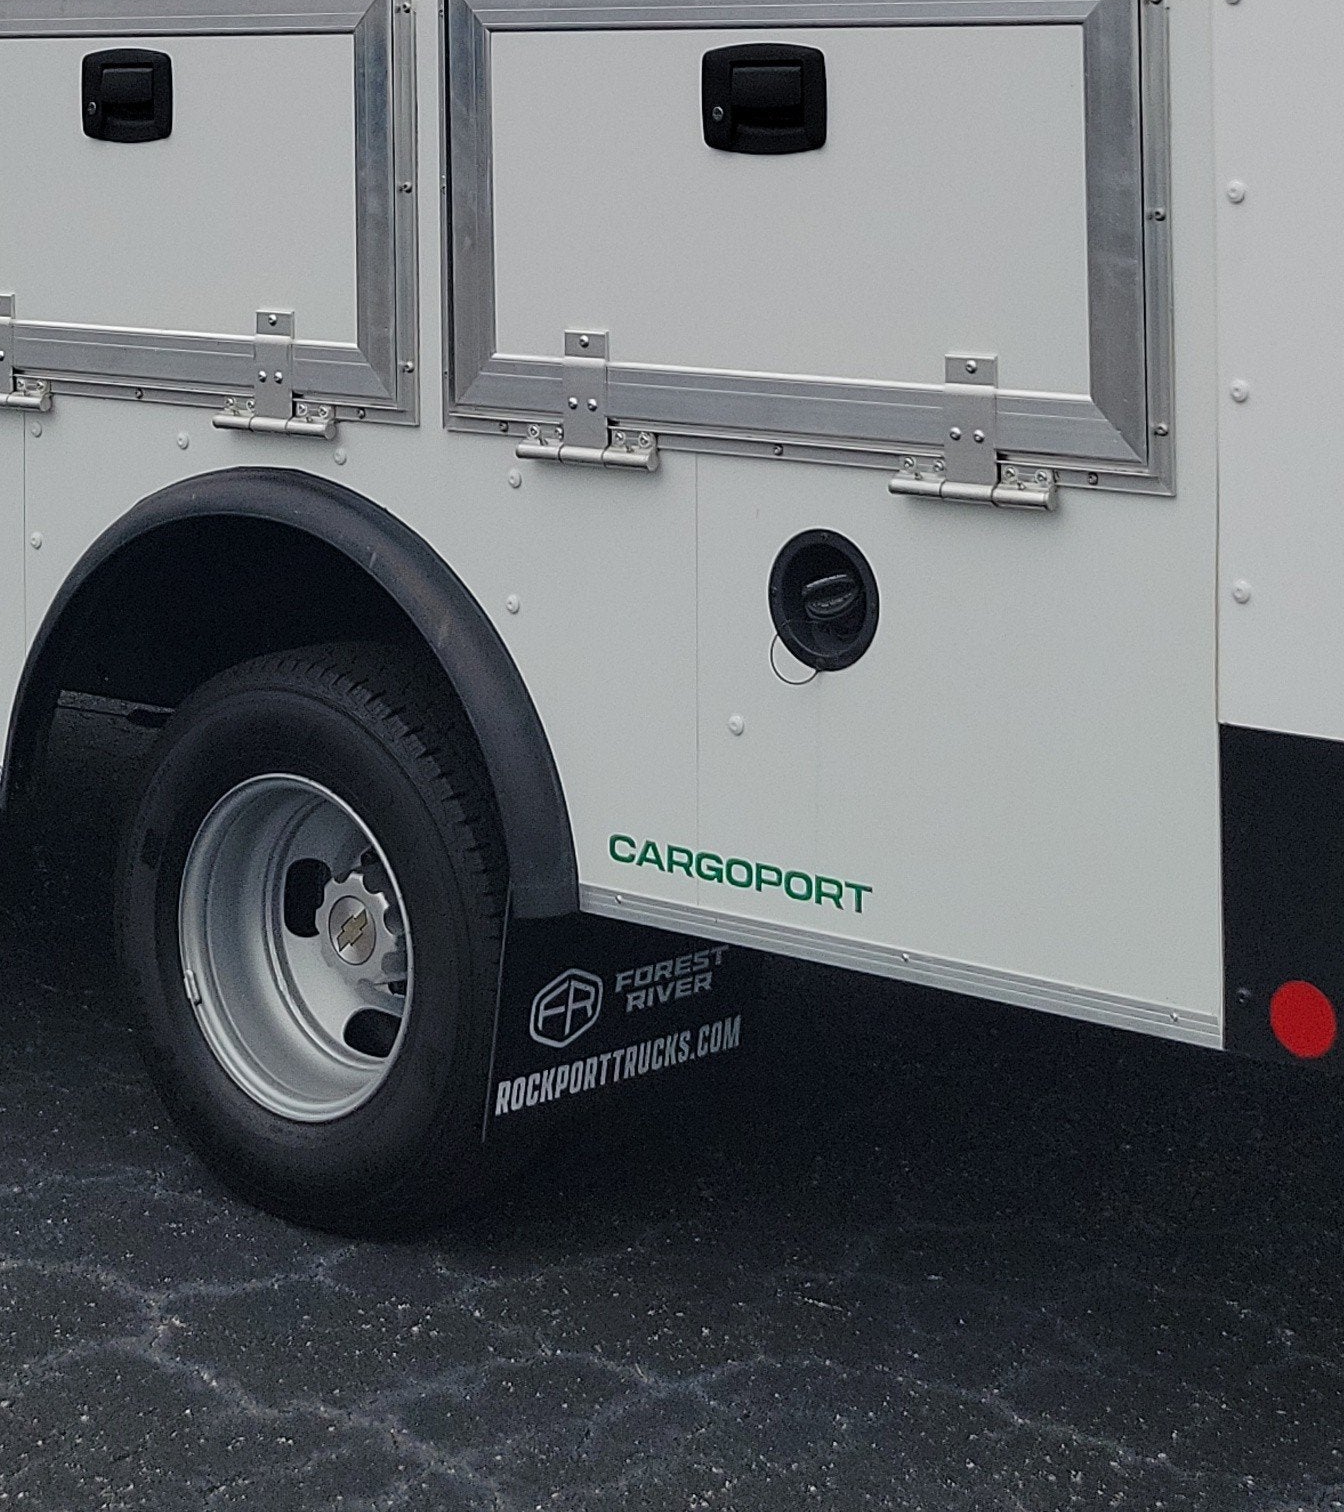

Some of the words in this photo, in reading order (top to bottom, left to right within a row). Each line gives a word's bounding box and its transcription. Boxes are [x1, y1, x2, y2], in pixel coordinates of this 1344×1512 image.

[608, 833, 873, 914] CARGOPORT
[615, 945, 730, 993] FOREST
[626, 971, 713, 1013] RIVER
[494, 1014, 742, 1116] ROCKPORTTRUCKS.COM
